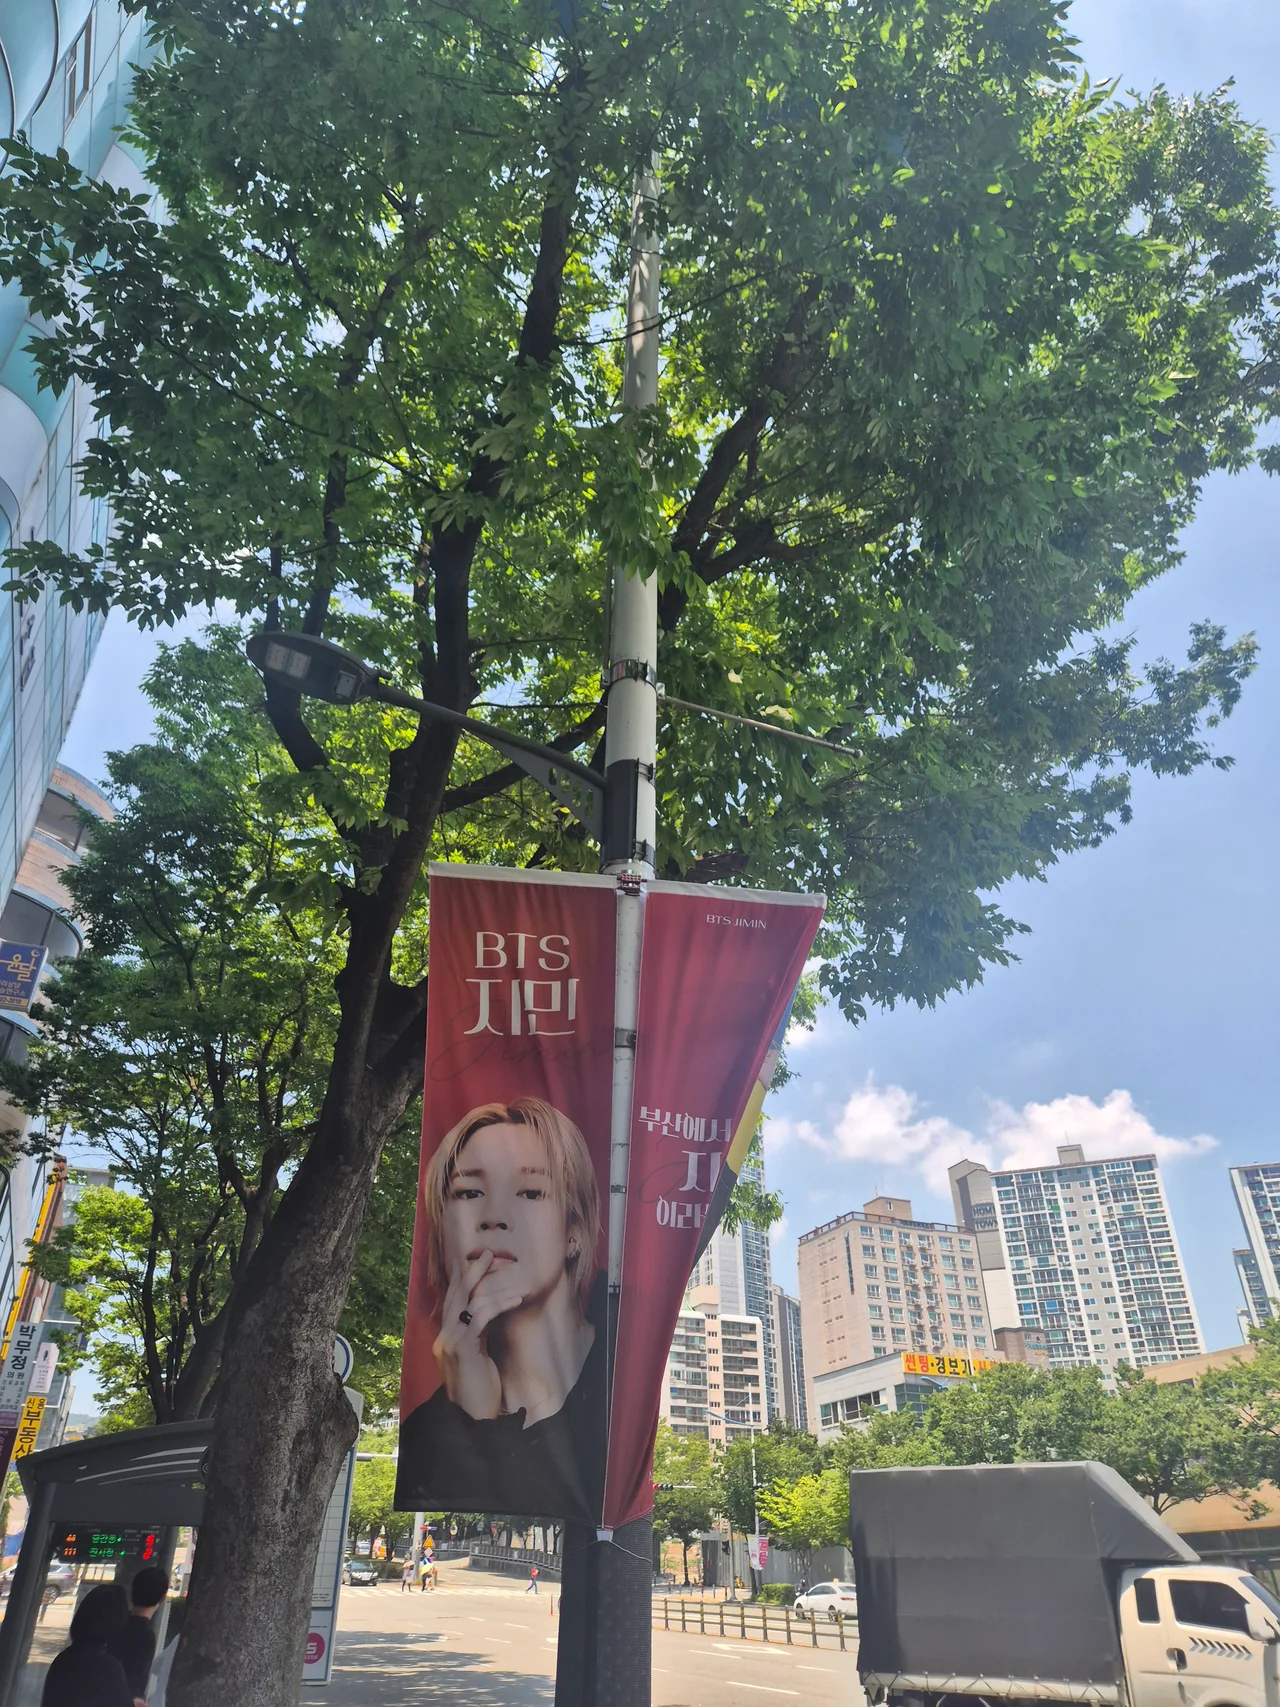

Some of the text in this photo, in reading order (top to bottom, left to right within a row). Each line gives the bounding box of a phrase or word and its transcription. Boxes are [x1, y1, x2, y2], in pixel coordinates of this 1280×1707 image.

[706, 914, 767, 930] BTS JIMIN
[474, 931, 570, 971] BTS
[463, 978, 580, 1036] 지민
[638, 1106, 733, 1143] 부산에서
[973, 1204, 996, 1216] HOM
[10, 1325, 36, 1370] 박무정
[26, 1398, 46, 1410] 신용
[15, 1410, 41, 1460] 부동산
